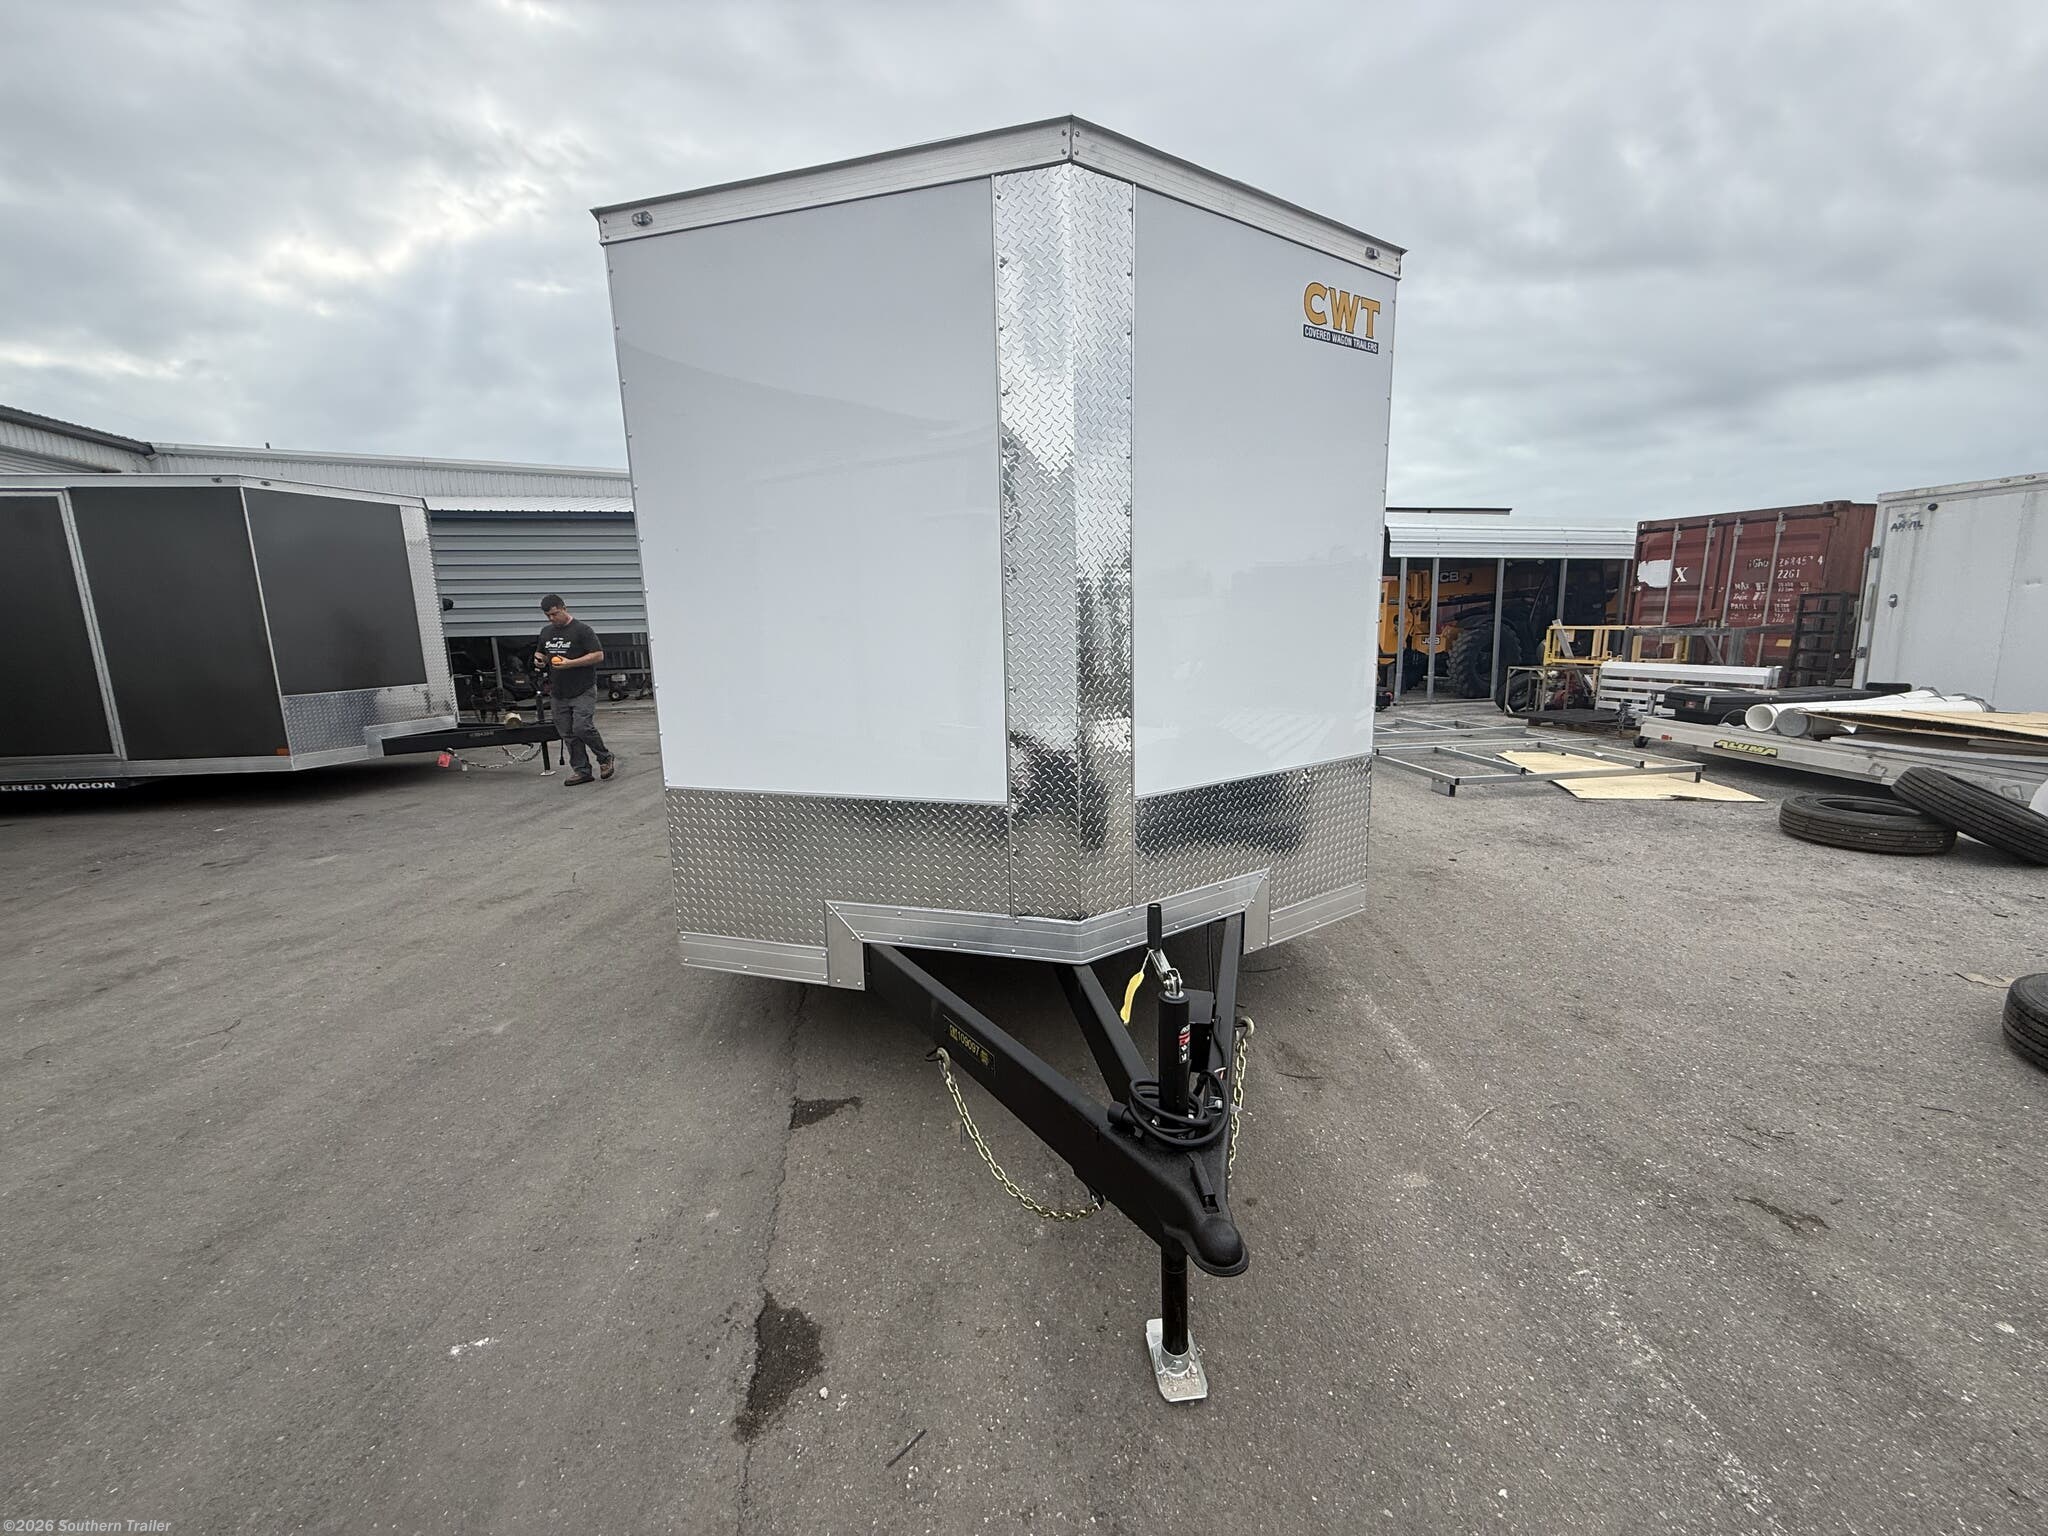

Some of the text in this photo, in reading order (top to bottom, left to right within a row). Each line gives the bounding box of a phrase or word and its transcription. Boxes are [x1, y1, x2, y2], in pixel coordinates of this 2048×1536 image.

[1304, 282, 1381, 339] CWT
[1304, 327, 1378, 353] COVERED WAGON TRAILERS
[1674, 567, 1688, 583] X
[1715, 740, 1777, 758] ALUMA
[51, 782, 116, 790] WAGON
